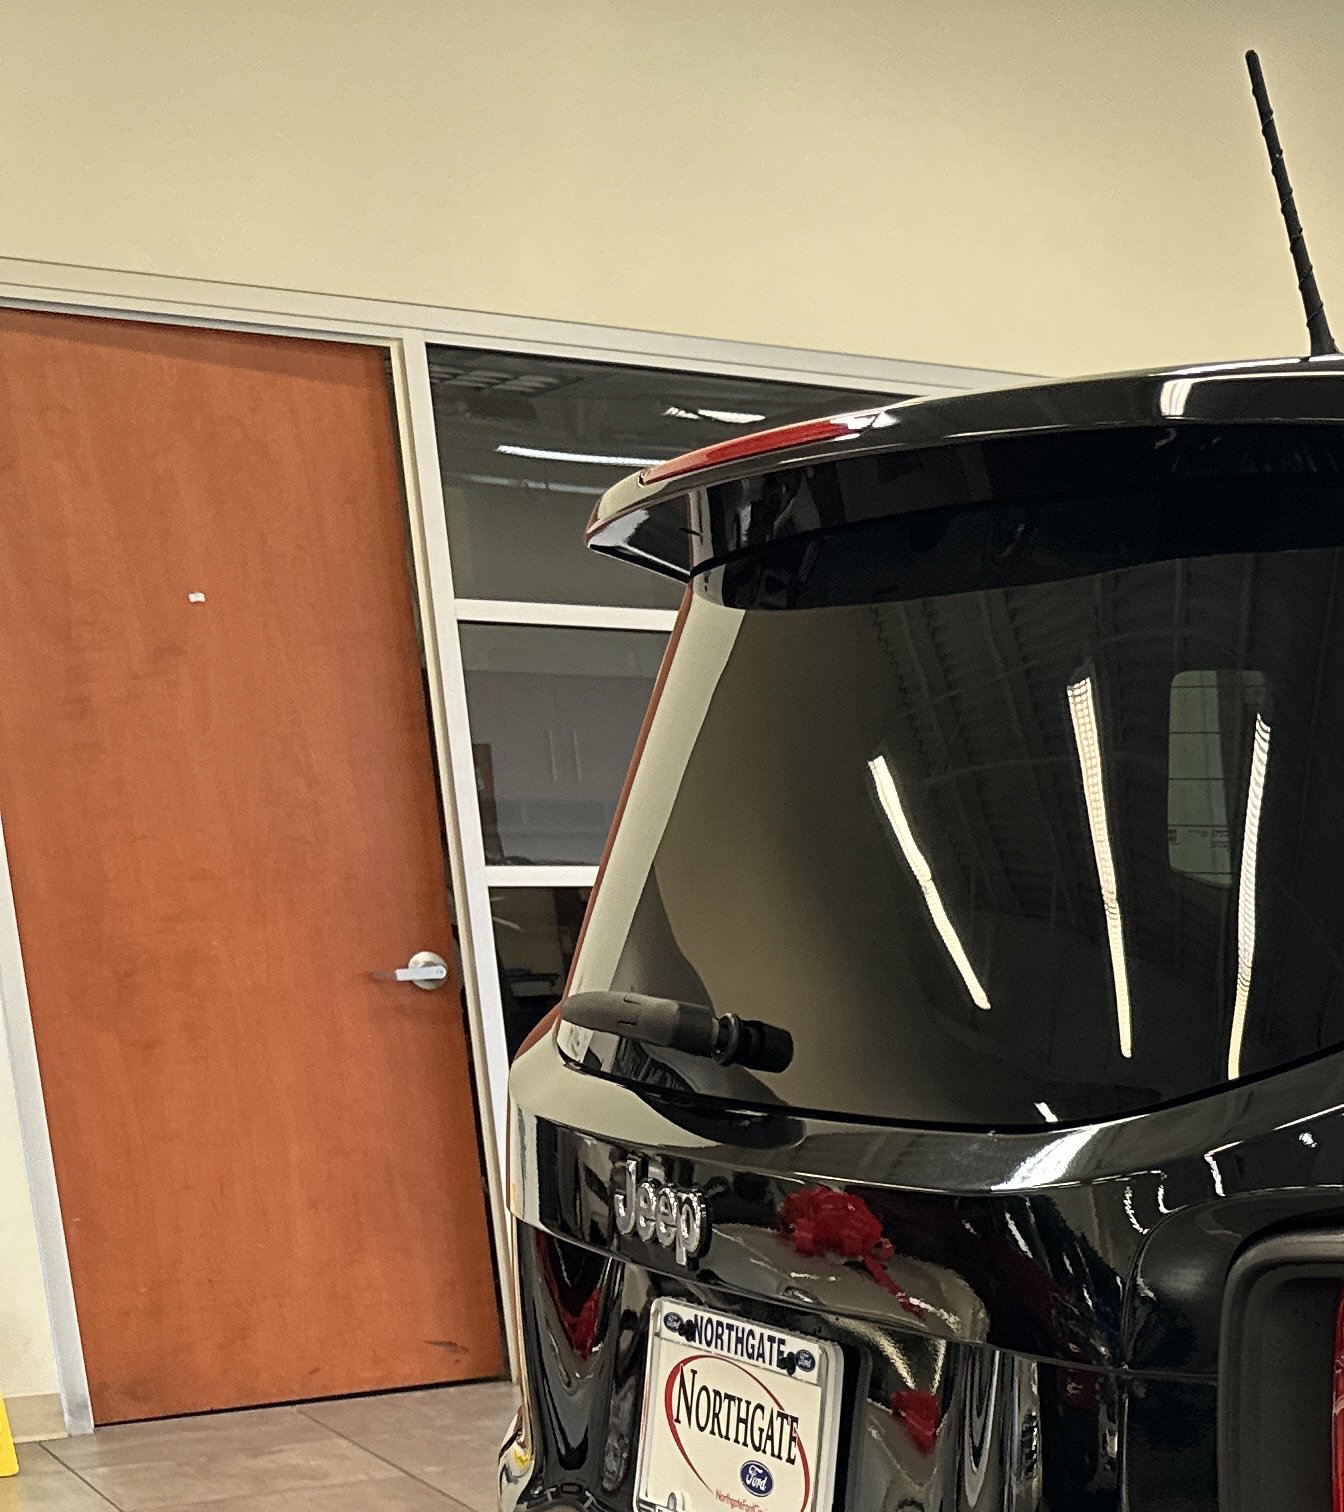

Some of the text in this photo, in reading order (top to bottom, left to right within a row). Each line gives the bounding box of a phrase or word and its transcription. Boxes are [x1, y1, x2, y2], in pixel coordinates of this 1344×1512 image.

[614, 1158, 705, 1266] Jeep
[694, 1314, 786, 1367] NORTHGATE
[674, 1364, 799, 1465] NORTHGATE
[743, 1462, 770, 1494] Ford
